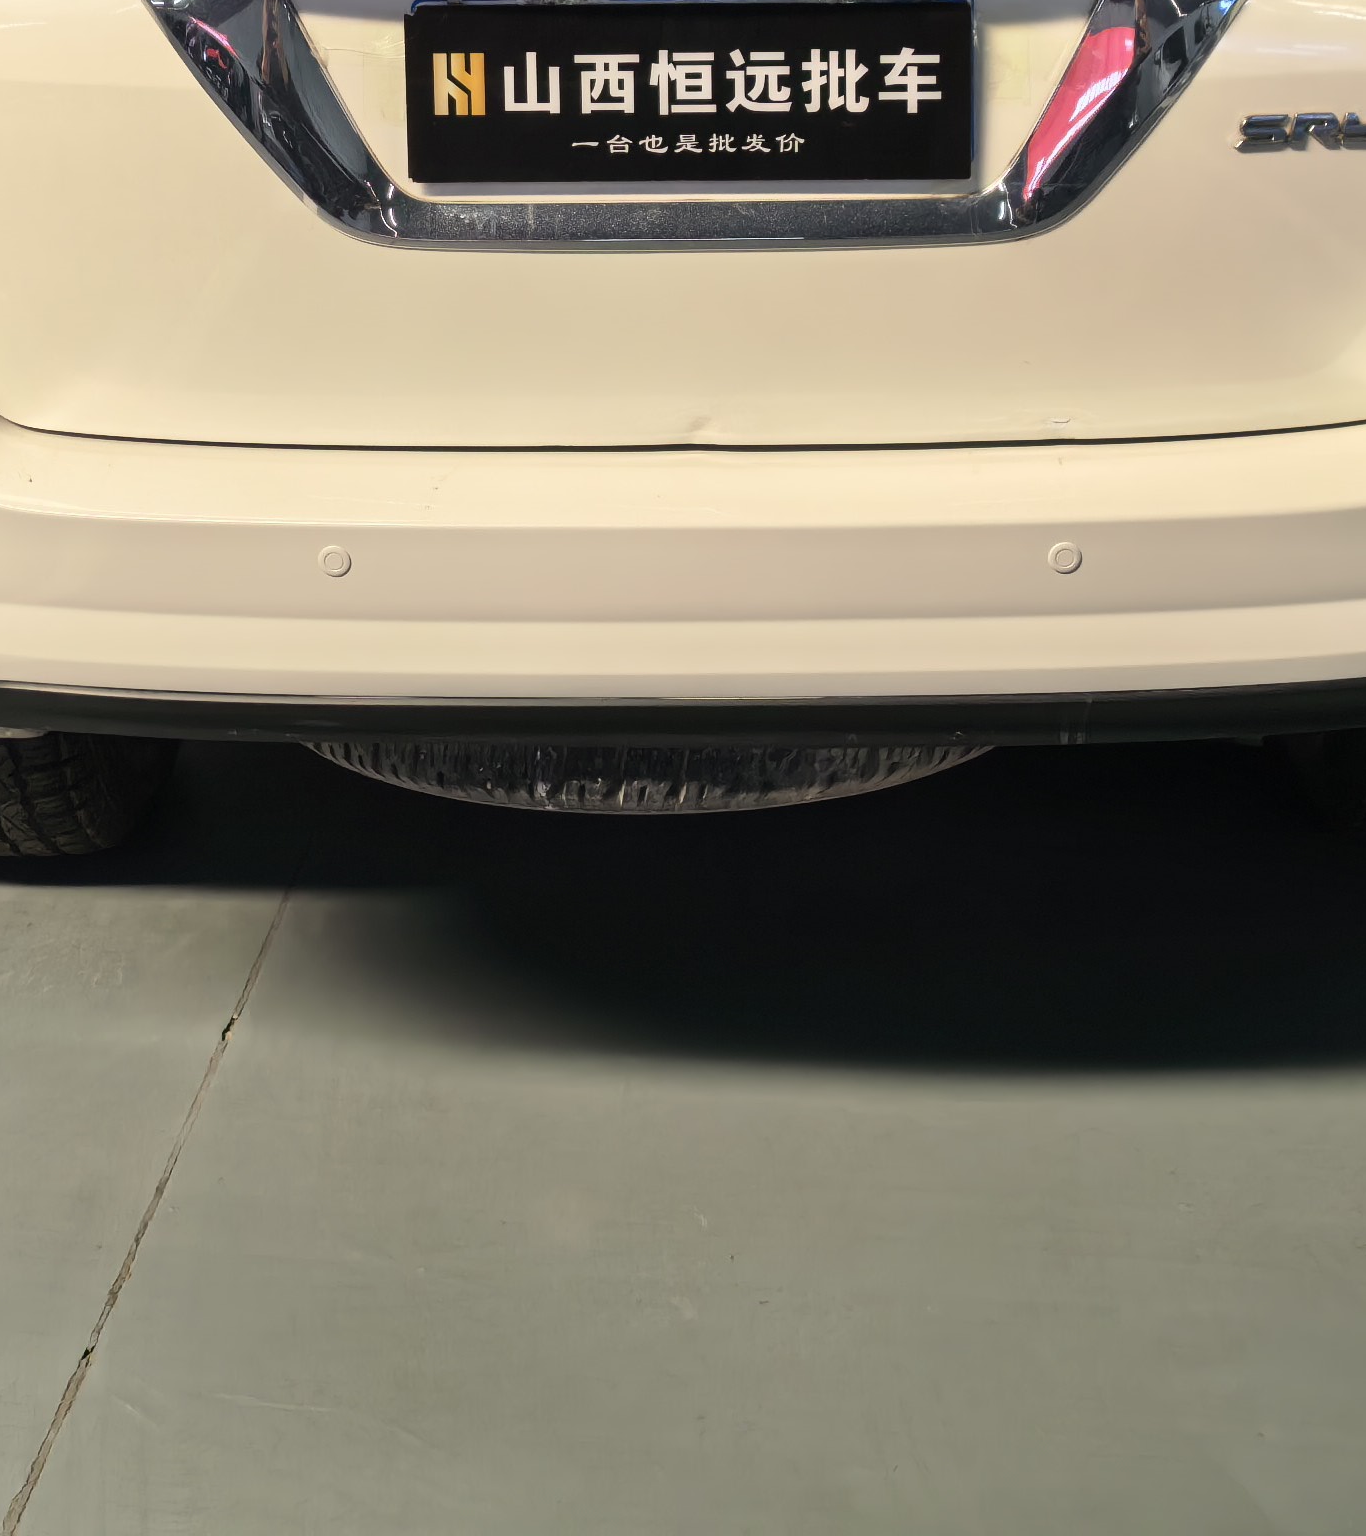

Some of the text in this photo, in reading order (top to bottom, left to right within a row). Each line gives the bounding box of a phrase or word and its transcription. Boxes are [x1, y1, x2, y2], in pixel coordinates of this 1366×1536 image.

[504, 48, 943, 115] 山西恒远批车
[571, 133, 806, 155] 一台也是批发价
